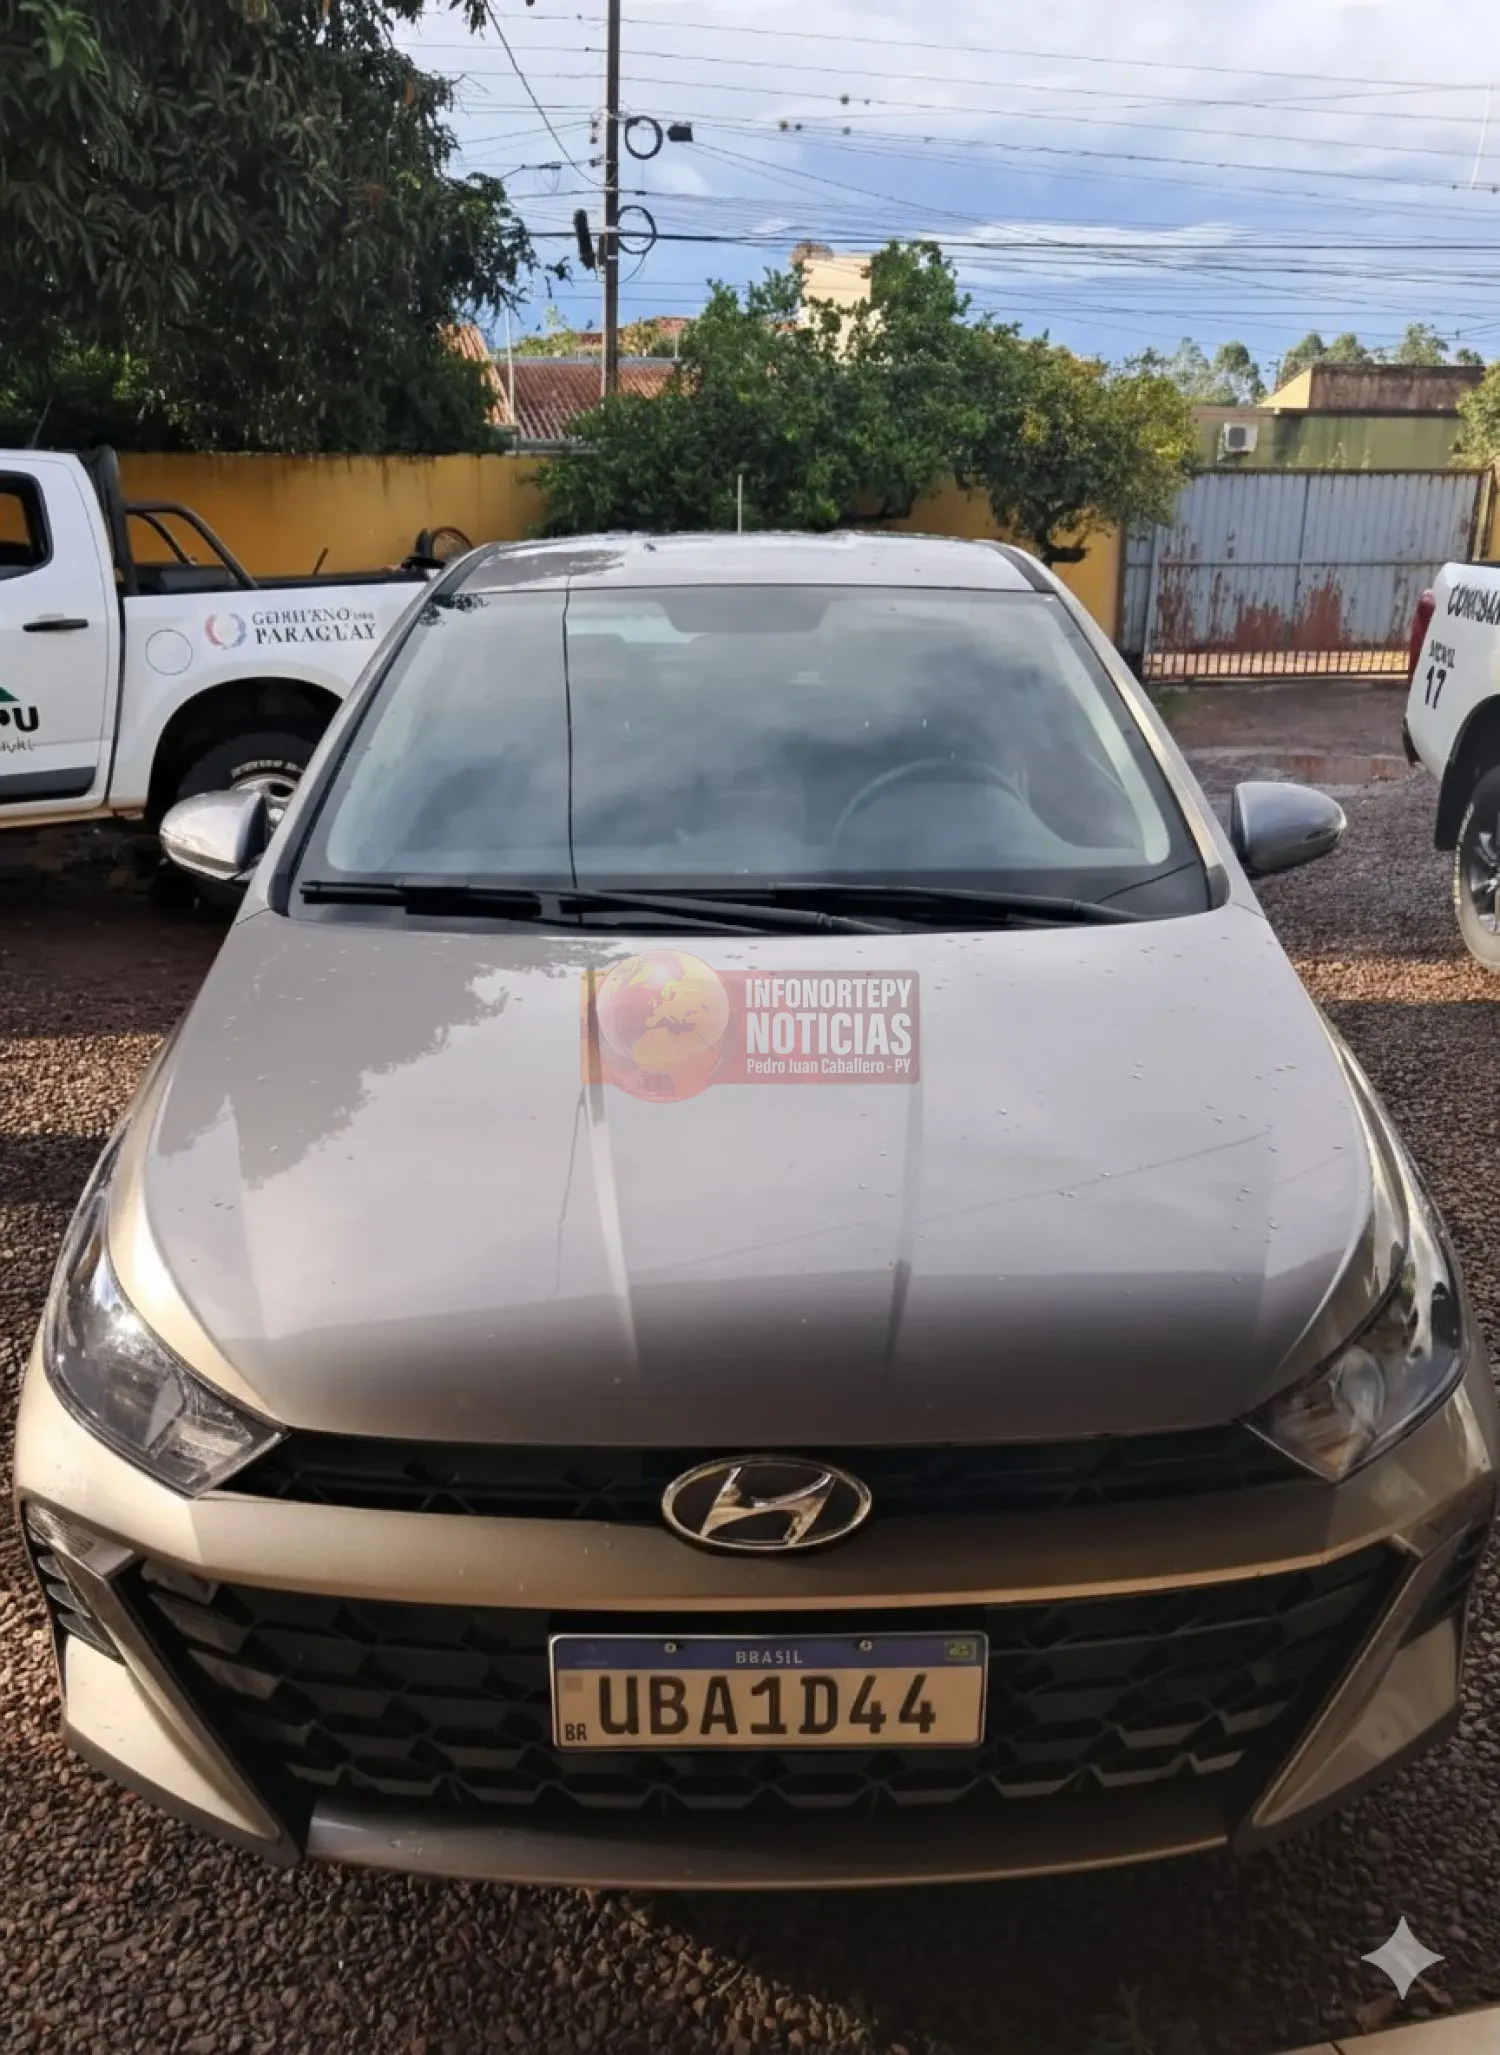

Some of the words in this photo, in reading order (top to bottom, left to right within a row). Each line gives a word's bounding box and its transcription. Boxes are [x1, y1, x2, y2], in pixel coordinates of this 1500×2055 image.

[255, 622, 376, 644] PARAGUAY
[1425, 665, 1446, 709] 17
[599, 1672, 937, 1736] UBA1D44
[564, 1722, 588, 1742] BR
